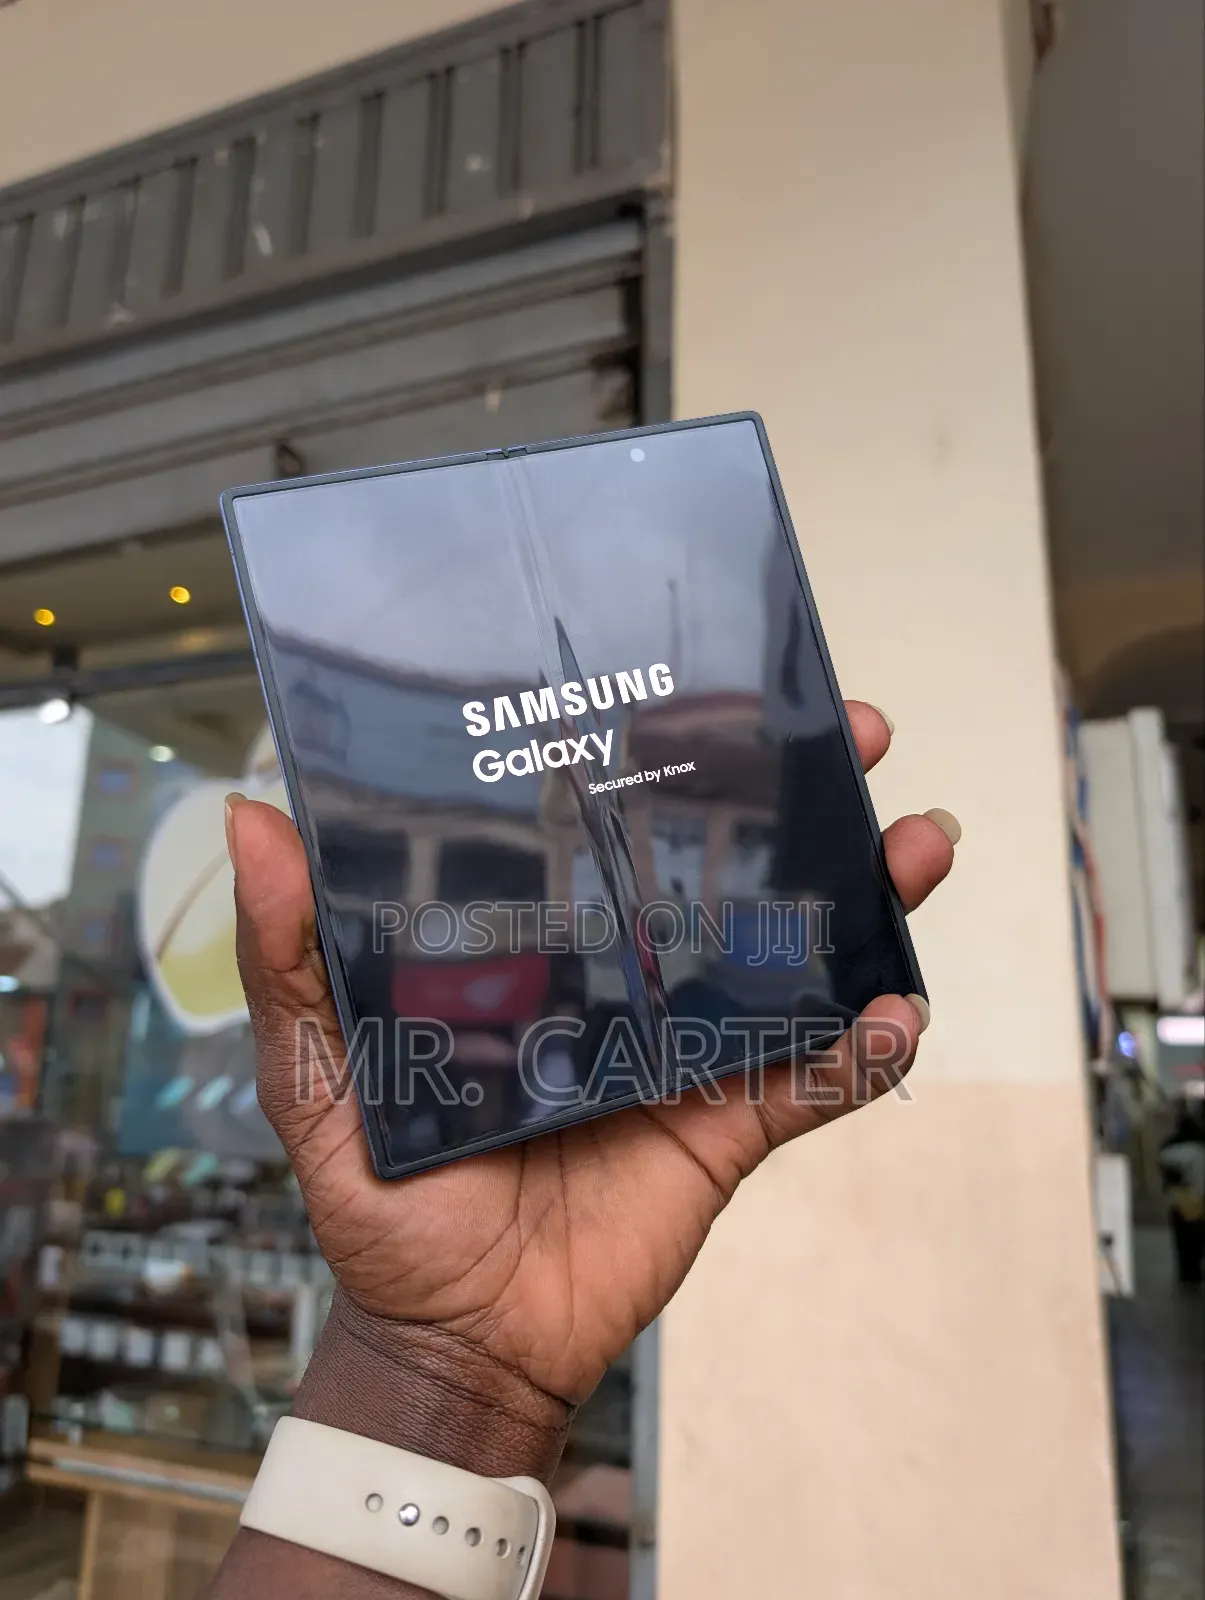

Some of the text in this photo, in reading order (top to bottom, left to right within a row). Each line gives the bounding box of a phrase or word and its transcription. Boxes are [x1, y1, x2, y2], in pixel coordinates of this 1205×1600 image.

[462, 663, 675, 737] SAMSUNG
[472, 729, 613, 783] Galaxy
[588, 761, 696, 795] Secured by Knox
